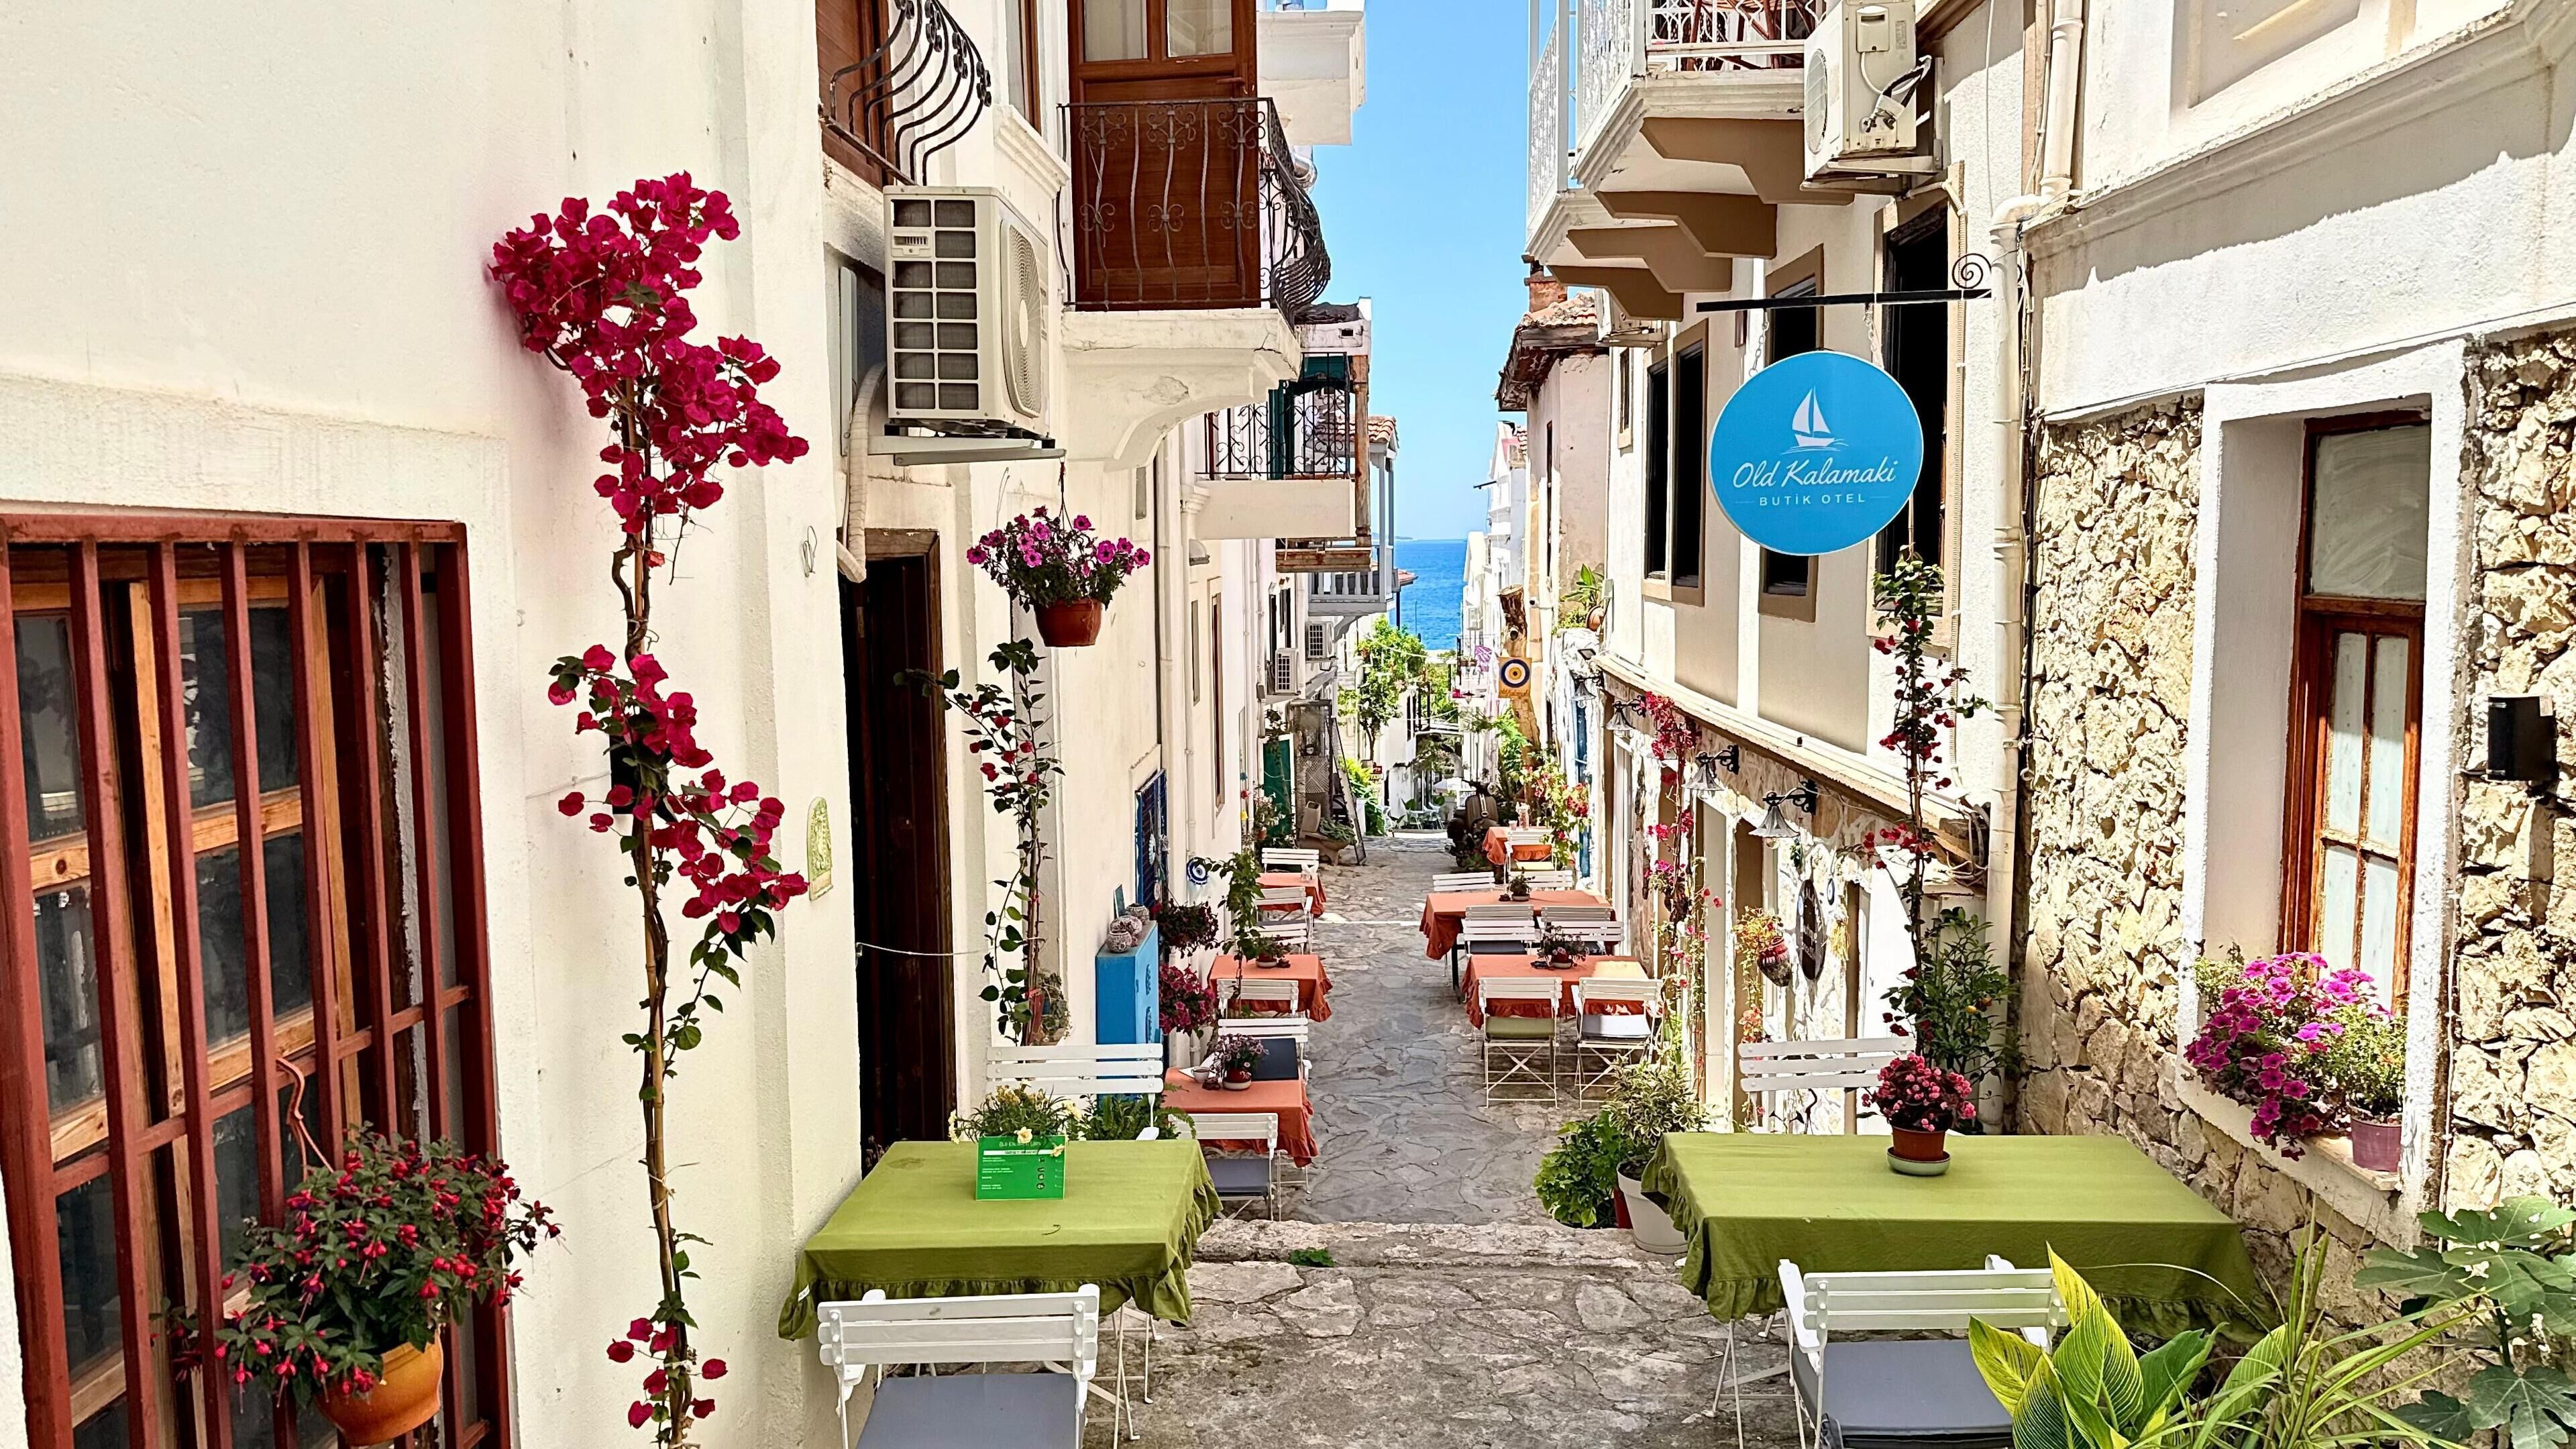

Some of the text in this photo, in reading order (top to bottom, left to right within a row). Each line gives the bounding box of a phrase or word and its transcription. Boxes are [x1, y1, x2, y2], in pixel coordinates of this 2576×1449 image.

[1733, 456, 1898, 488] Old Kalamaki
[1760, 493, 1866, 506] BUTİK OTEL
